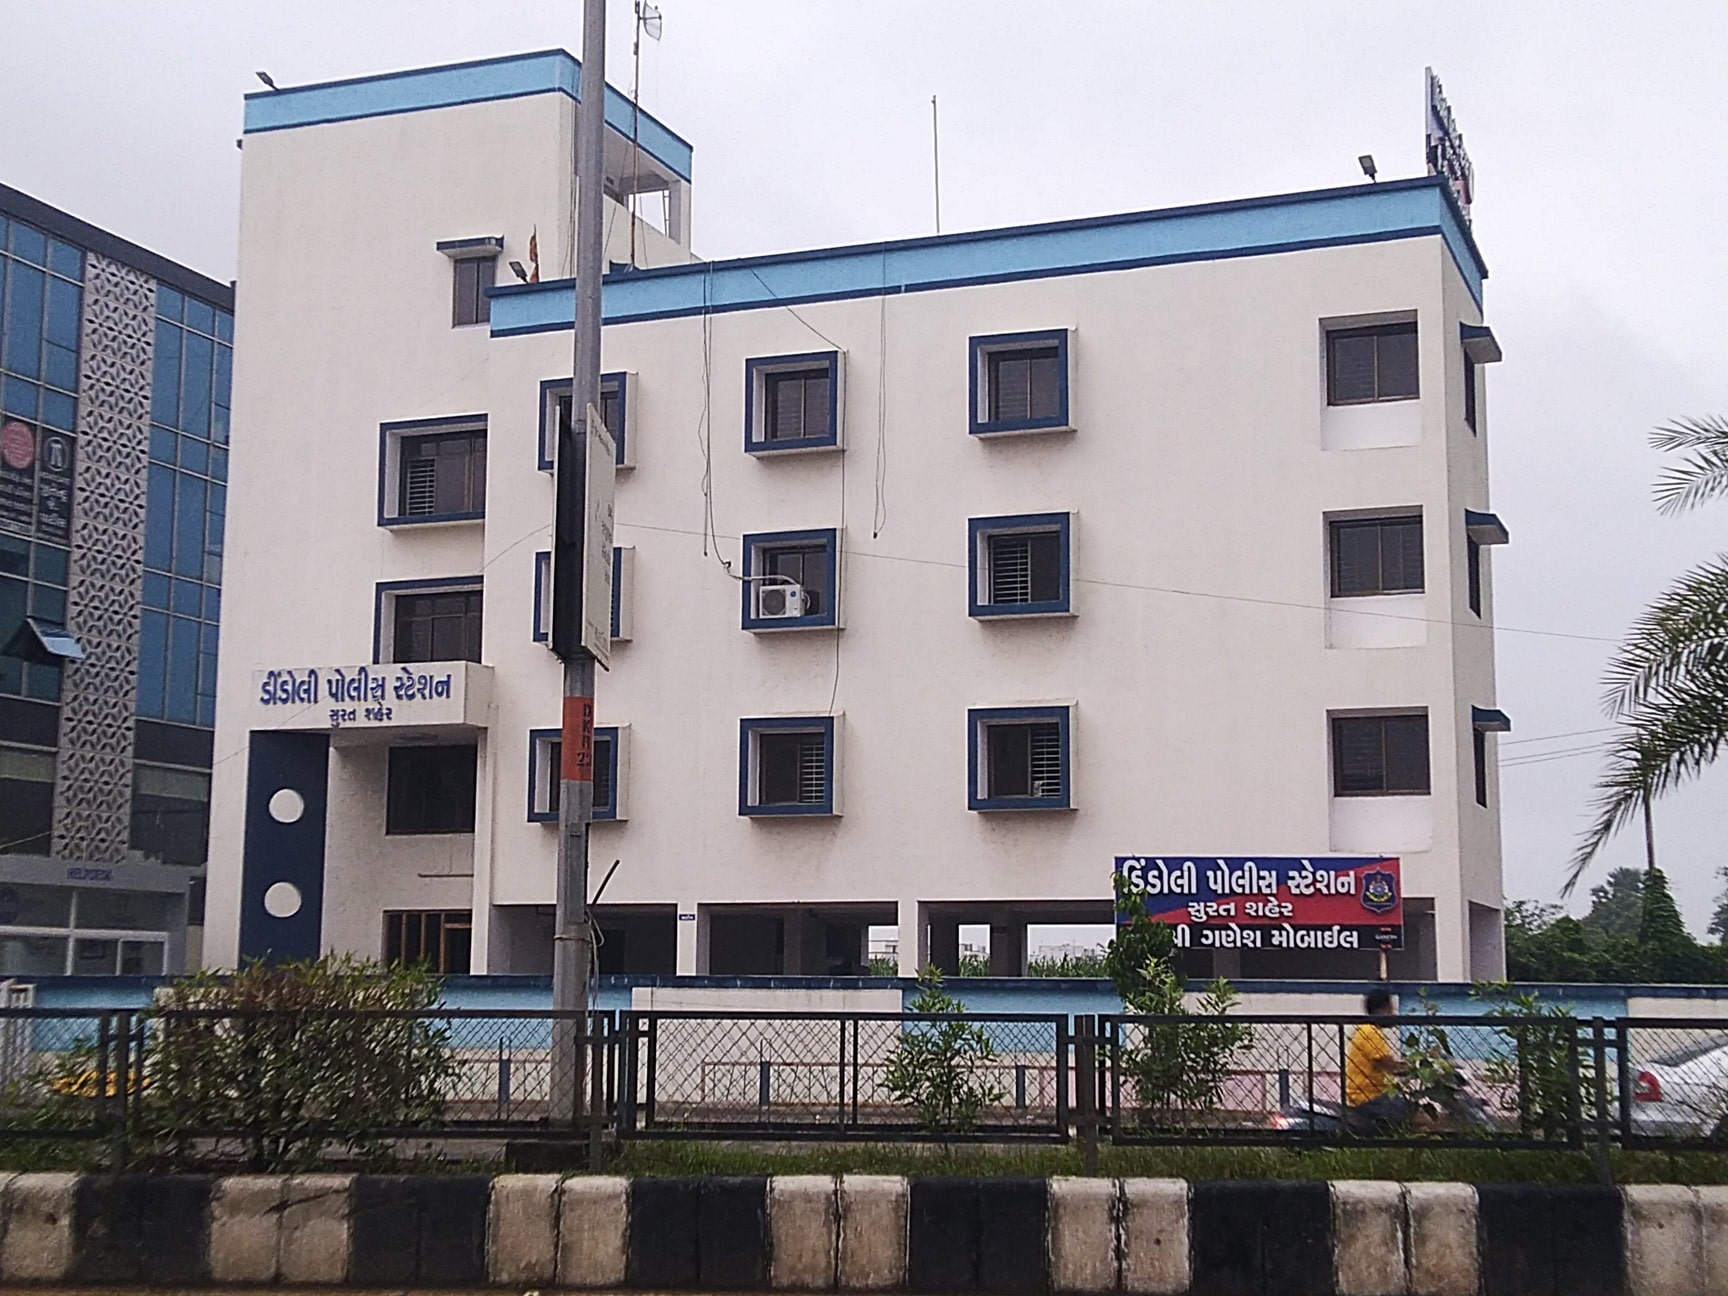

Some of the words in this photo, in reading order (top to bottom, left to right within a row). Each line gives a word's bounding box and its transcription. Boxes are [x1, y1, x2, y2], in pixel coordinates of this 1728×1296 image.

[260, 669, 319, 704] ડીંડોલી
[327, 666, 386, 702] પોલીસ
[393, 667, 452, 701] સ્ટેશન
[329, 708, 357, 728] સુરત
[364, 702, 393, 721] શહેર
[1122, 859, 1197, 894] ડિંડોલી
[1206, 859, 1277, 894] પોલીસ
[1287, 859, 1356, 895] સ્ટેશન
[1188, 902, 1236, 922] સુરત
[1245, 896, 1294, 917] શહેર
[1200, 923, 1262, 948] ગણેશ
[1271, 923, 1359, 949] મોબાઈલ
